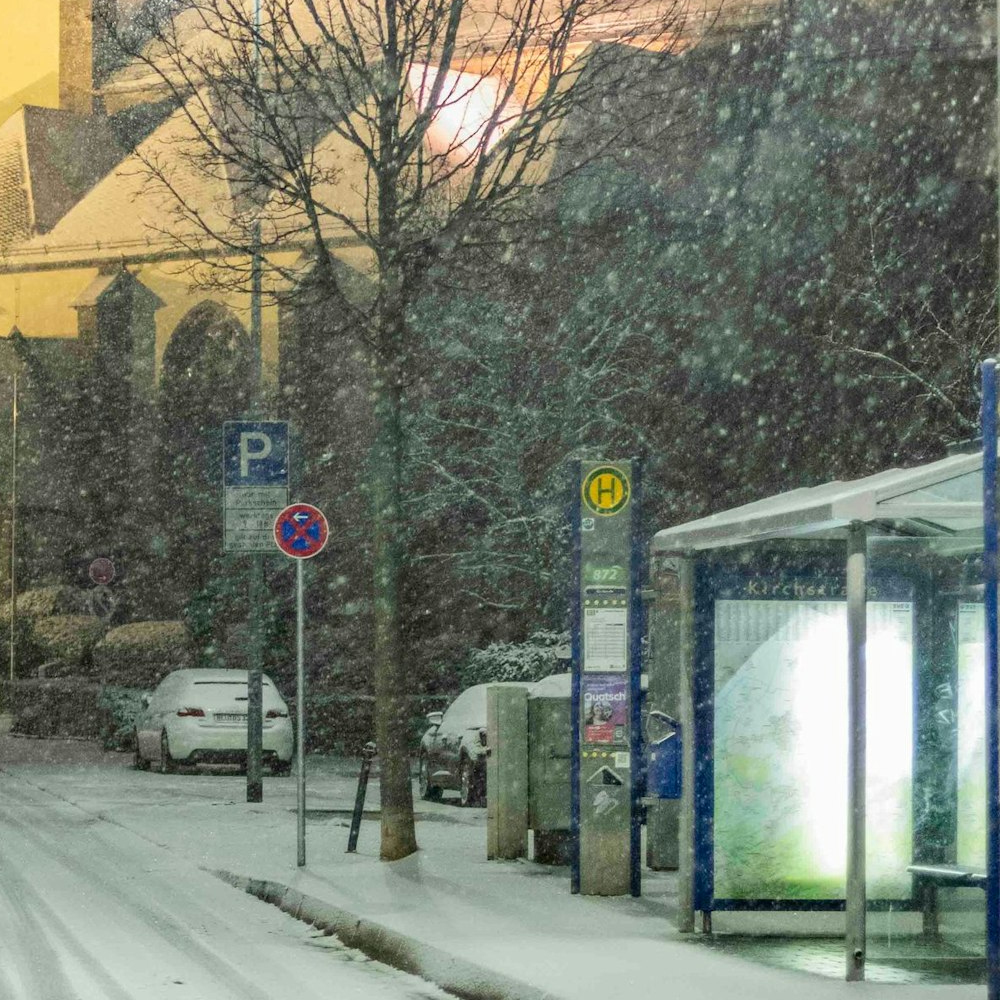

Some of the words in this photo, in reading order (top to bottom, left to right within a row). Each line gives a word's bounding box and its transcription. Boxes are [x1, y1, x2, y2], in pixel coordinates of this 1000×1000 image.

[241, 432, 272, 477] P
[597, 477, 615, 505] H
[593, 569, 617, 580] 872
[746, 580, 879, 597] Kirchstrae
[584, 692, 626, 702] Quatsch
